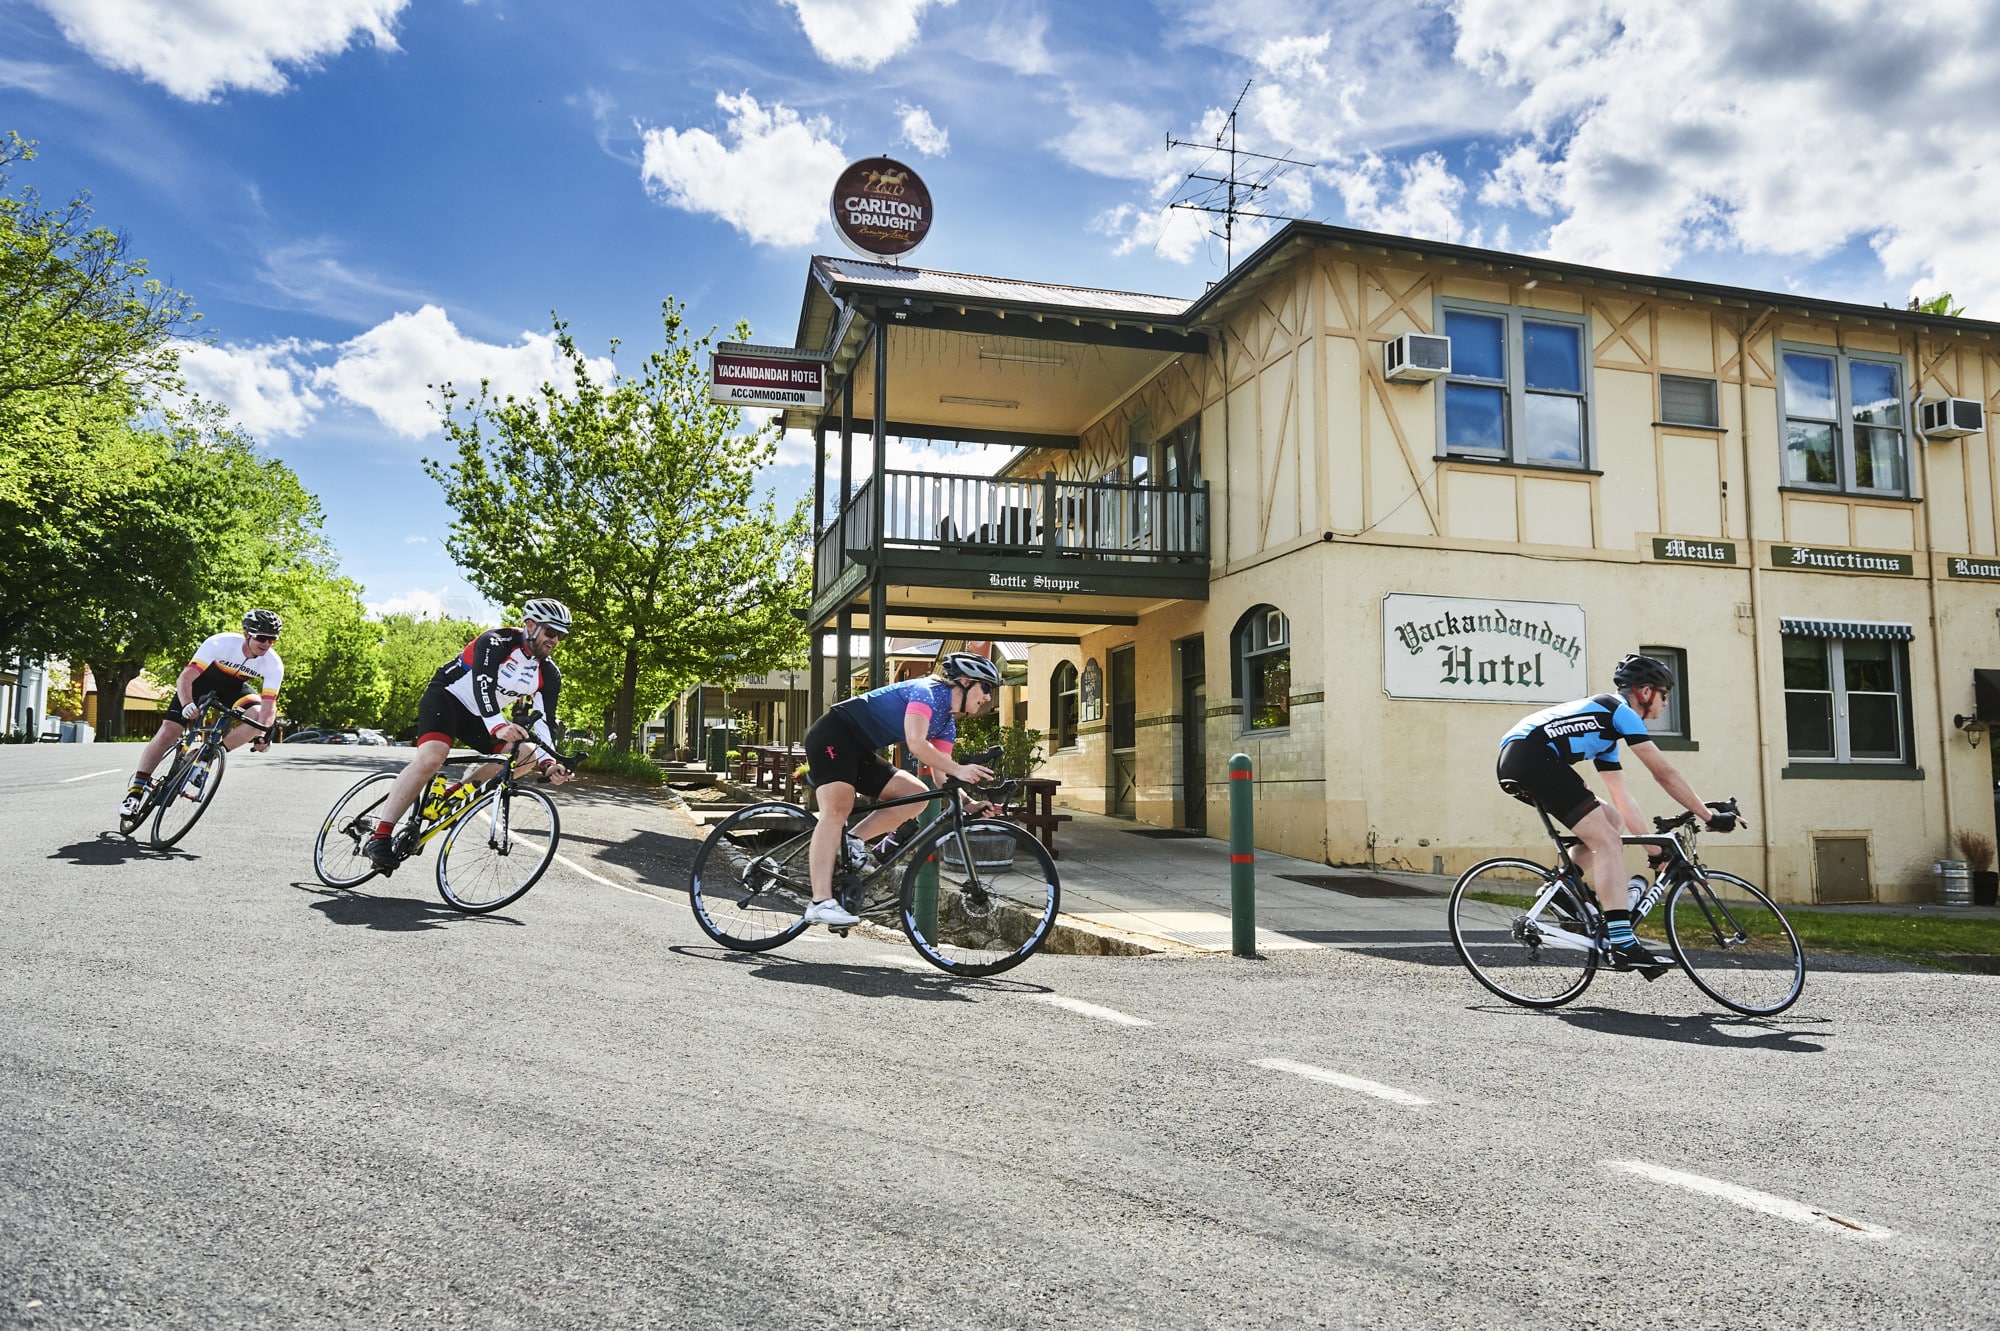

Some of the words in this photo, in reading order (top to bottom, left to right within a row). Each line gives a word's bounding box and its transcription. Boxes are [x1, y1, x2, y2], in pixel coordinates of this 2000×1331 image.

[844, 196, 922, 220] CARLTON
[850, 212, 917, 231] DRAUGHT
[718, 364, 789, 382] YACKANDANDAH
[791, 370, 819, 383] HOTEL
[731, 388, 806, 402] ACCOMMODATION
[1665, 539, 1725, 560] Meals
[1790, 547, 1900, 571] Functions
[989, 573, 1027, 587] Bottle
[1033, 574, 1080, 591] Shoppe
[1394, 608, 1582, 669] Yackandandah
[1437, 644, 1545, 688] Hotel
[480, 680, 494, 713] CUBE
[1544, 716, 1606, 739] hummel
[1637, 872, 1671, 917] BMC
